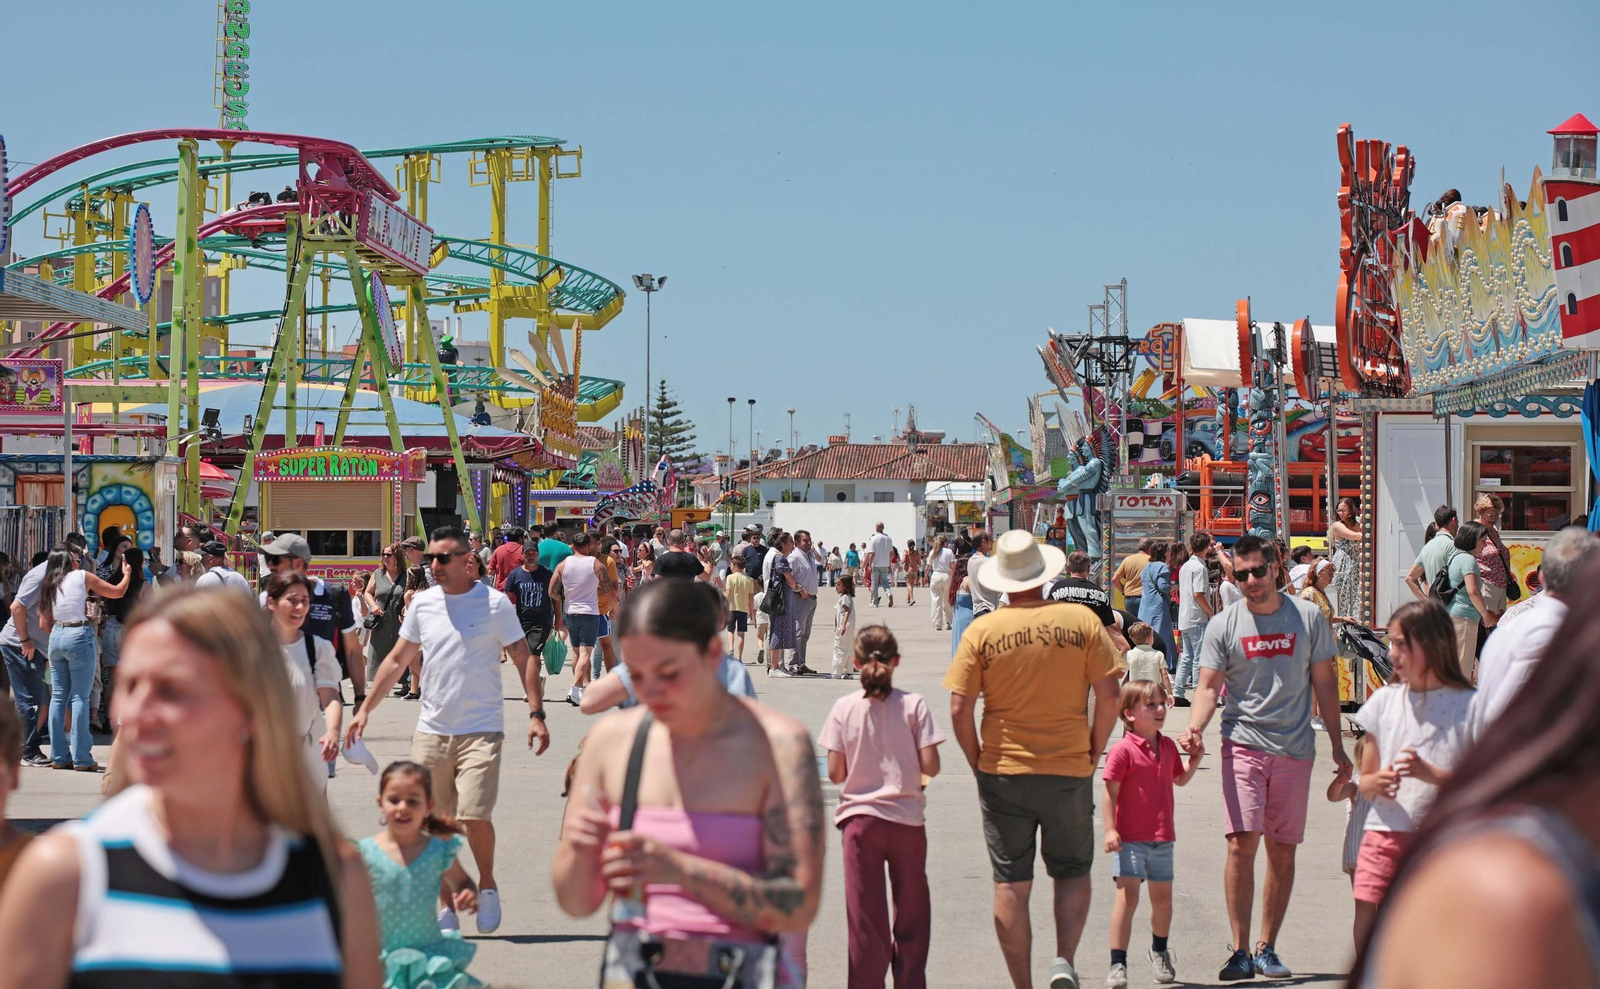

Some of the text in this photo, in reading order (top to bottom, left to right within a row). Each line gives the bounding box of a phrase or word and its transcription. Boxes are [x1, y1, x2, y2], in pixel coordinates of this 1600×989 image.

[279, 454, 378, 477] SUPER RATÓN
[1117, 495, 1174, 508] TOTEM
[979, 619, 1087, 671] Detroit Squad
